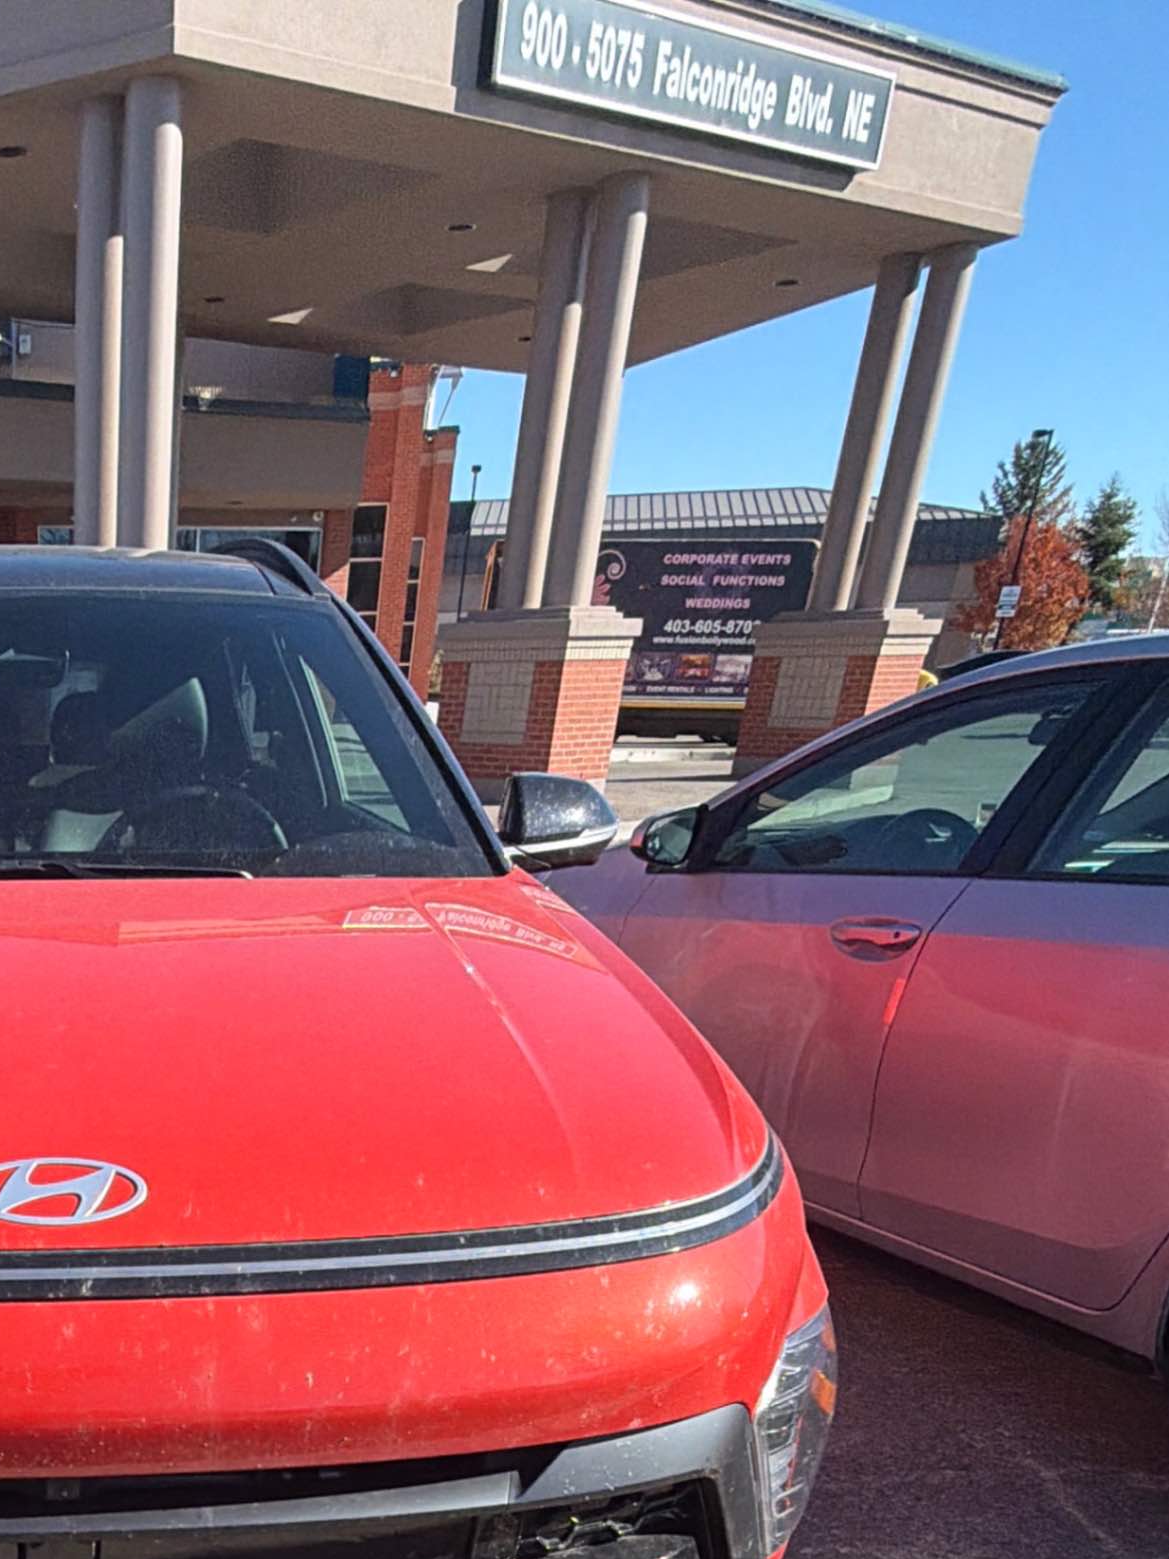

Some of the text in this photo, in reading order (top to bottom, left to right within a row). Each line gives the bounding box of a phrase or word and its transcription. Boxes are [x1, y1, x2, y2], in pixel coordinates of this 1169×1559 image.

[520, 2, 568, 71] 900
[585, 18, 646, 89] 5075
[652, 39, 778, 130] Falconridge
[785, 73, 834, 135] Blvd.
[841, 88, 876, 144] NE
[663, 553, 792, 566] CORPORATE EVENTS
[660, 574, 785, 587] SOCIAL FUNCTIONS
[685, 597, 751, 609] WEDDINGS
[663, 618, 762, 634] 403-605-870
